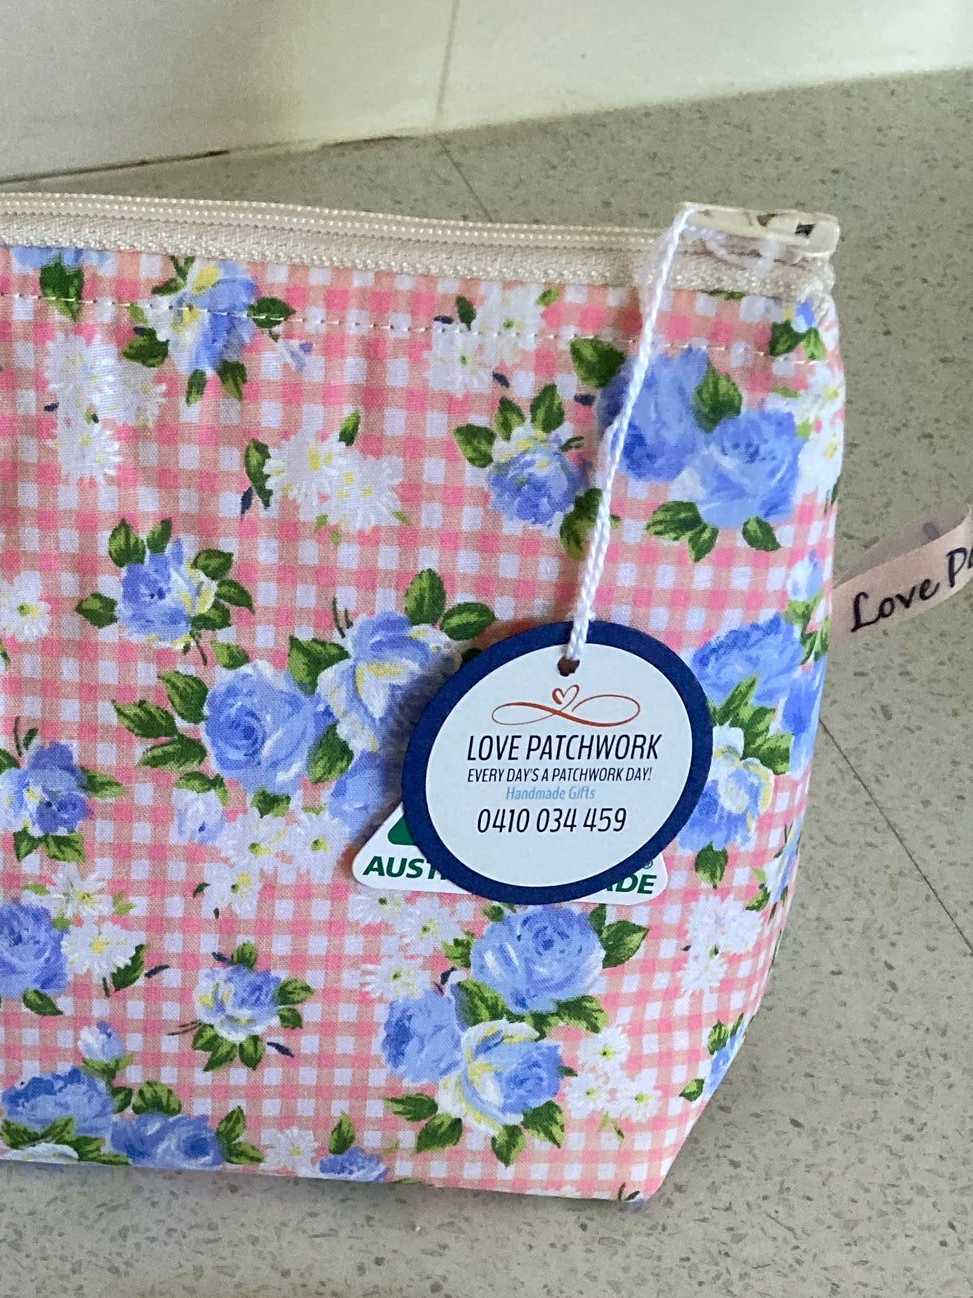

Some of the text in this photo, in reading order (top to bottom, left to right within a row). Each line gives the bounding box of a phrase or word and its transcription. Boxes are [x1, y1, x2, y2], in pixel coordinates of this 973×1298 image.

[851, 547, 973, 632] Love P
[467, 734, 662, 761] LOVE PATCHWORK
[468, 767, 652, 782] EVERY DAY'S A PATCHWORK DAY!
[506, 786, 595, 800] Handmade Gifts
[477, 808, 627, 833] 0410 034 459
